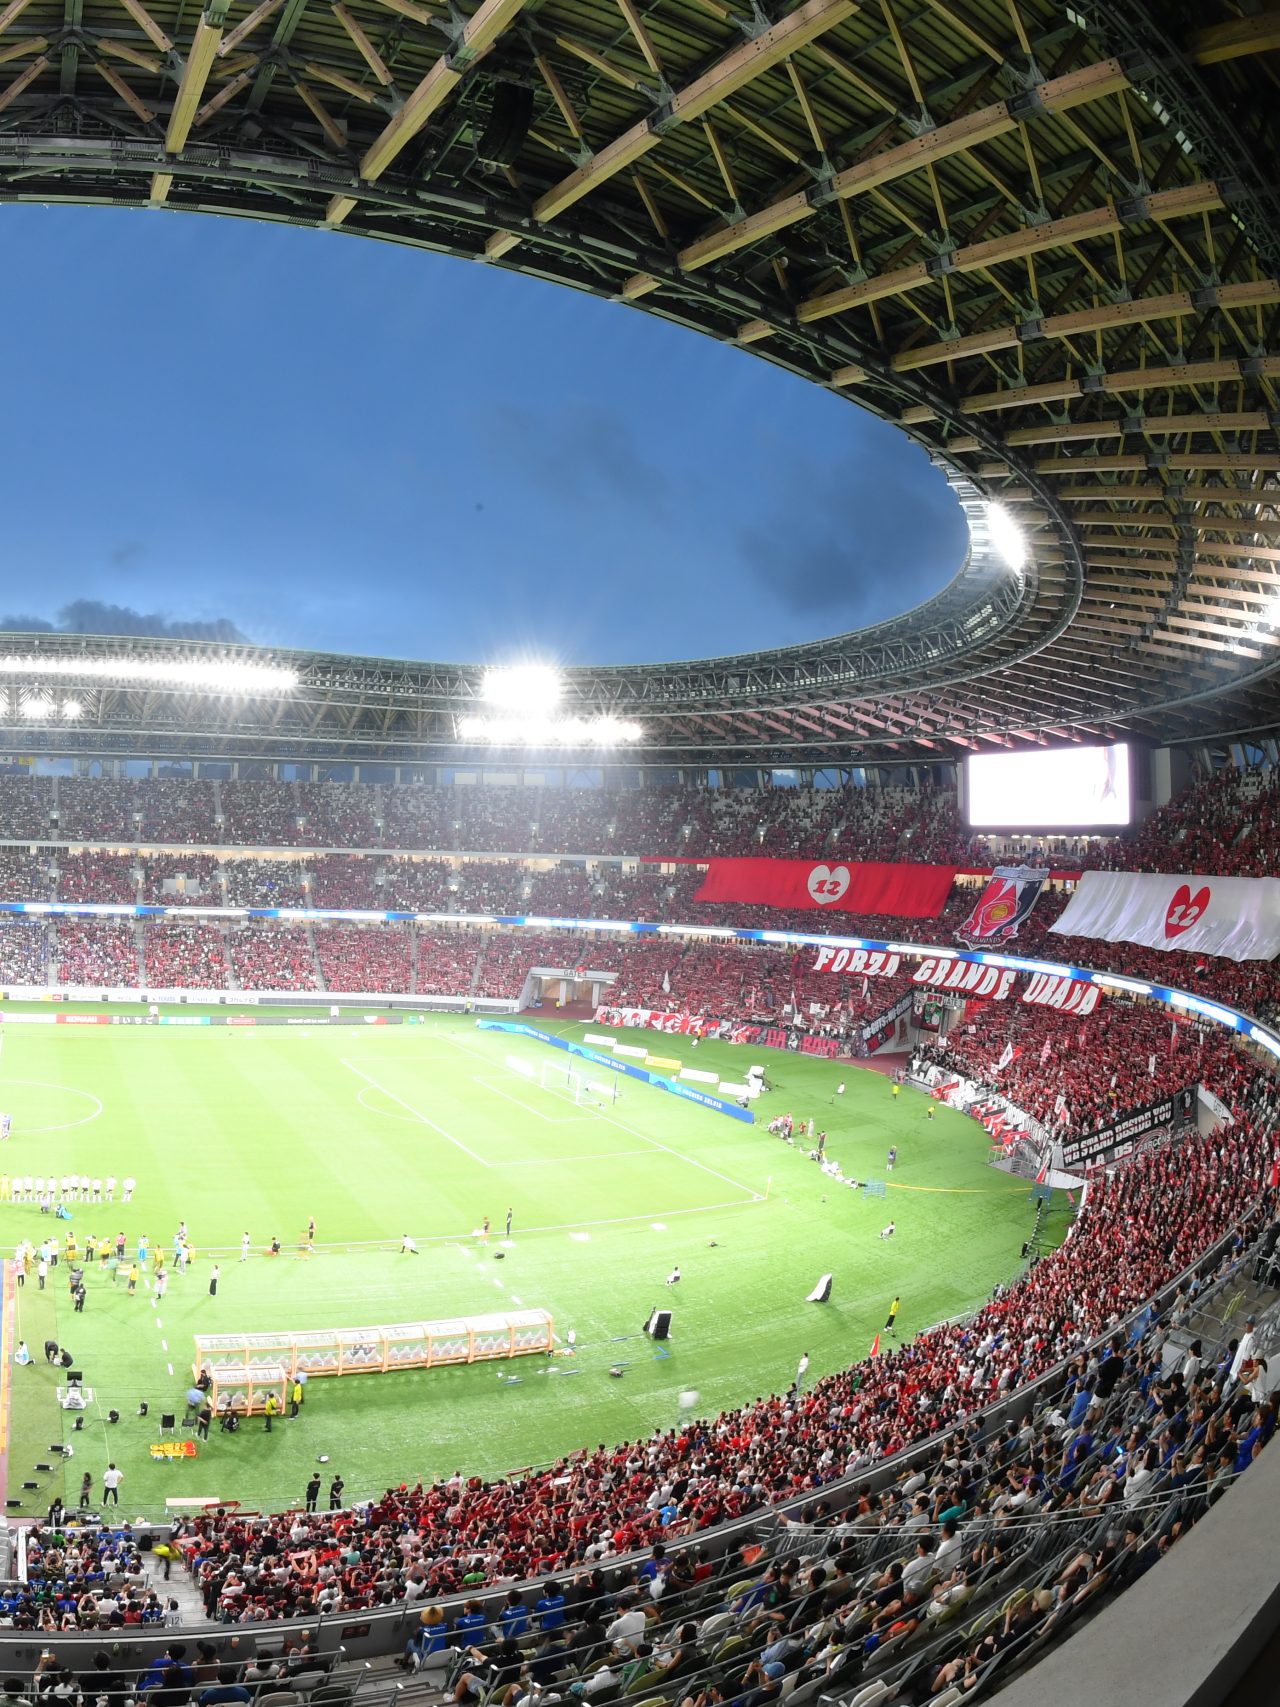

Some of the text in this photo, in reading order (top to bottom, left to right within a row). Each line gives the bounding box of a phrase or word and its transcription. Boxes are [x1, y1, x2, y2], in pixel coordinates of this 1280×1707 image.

[813, 879, 842, 895] 12
[1168, 904, 1199, 926] 12
[813, 947, 1099, 1015] FORZA GRANDE URAWA
[1063, 1141, 1080, 1164] WE
[1080, 1129, 1114, 1157] STAND
[1115, 1111, 1152, 1142] BESIDE
[1153, 1102, 1172, 1124] YOU
[1085, 1153, 1105, 1170] LA
